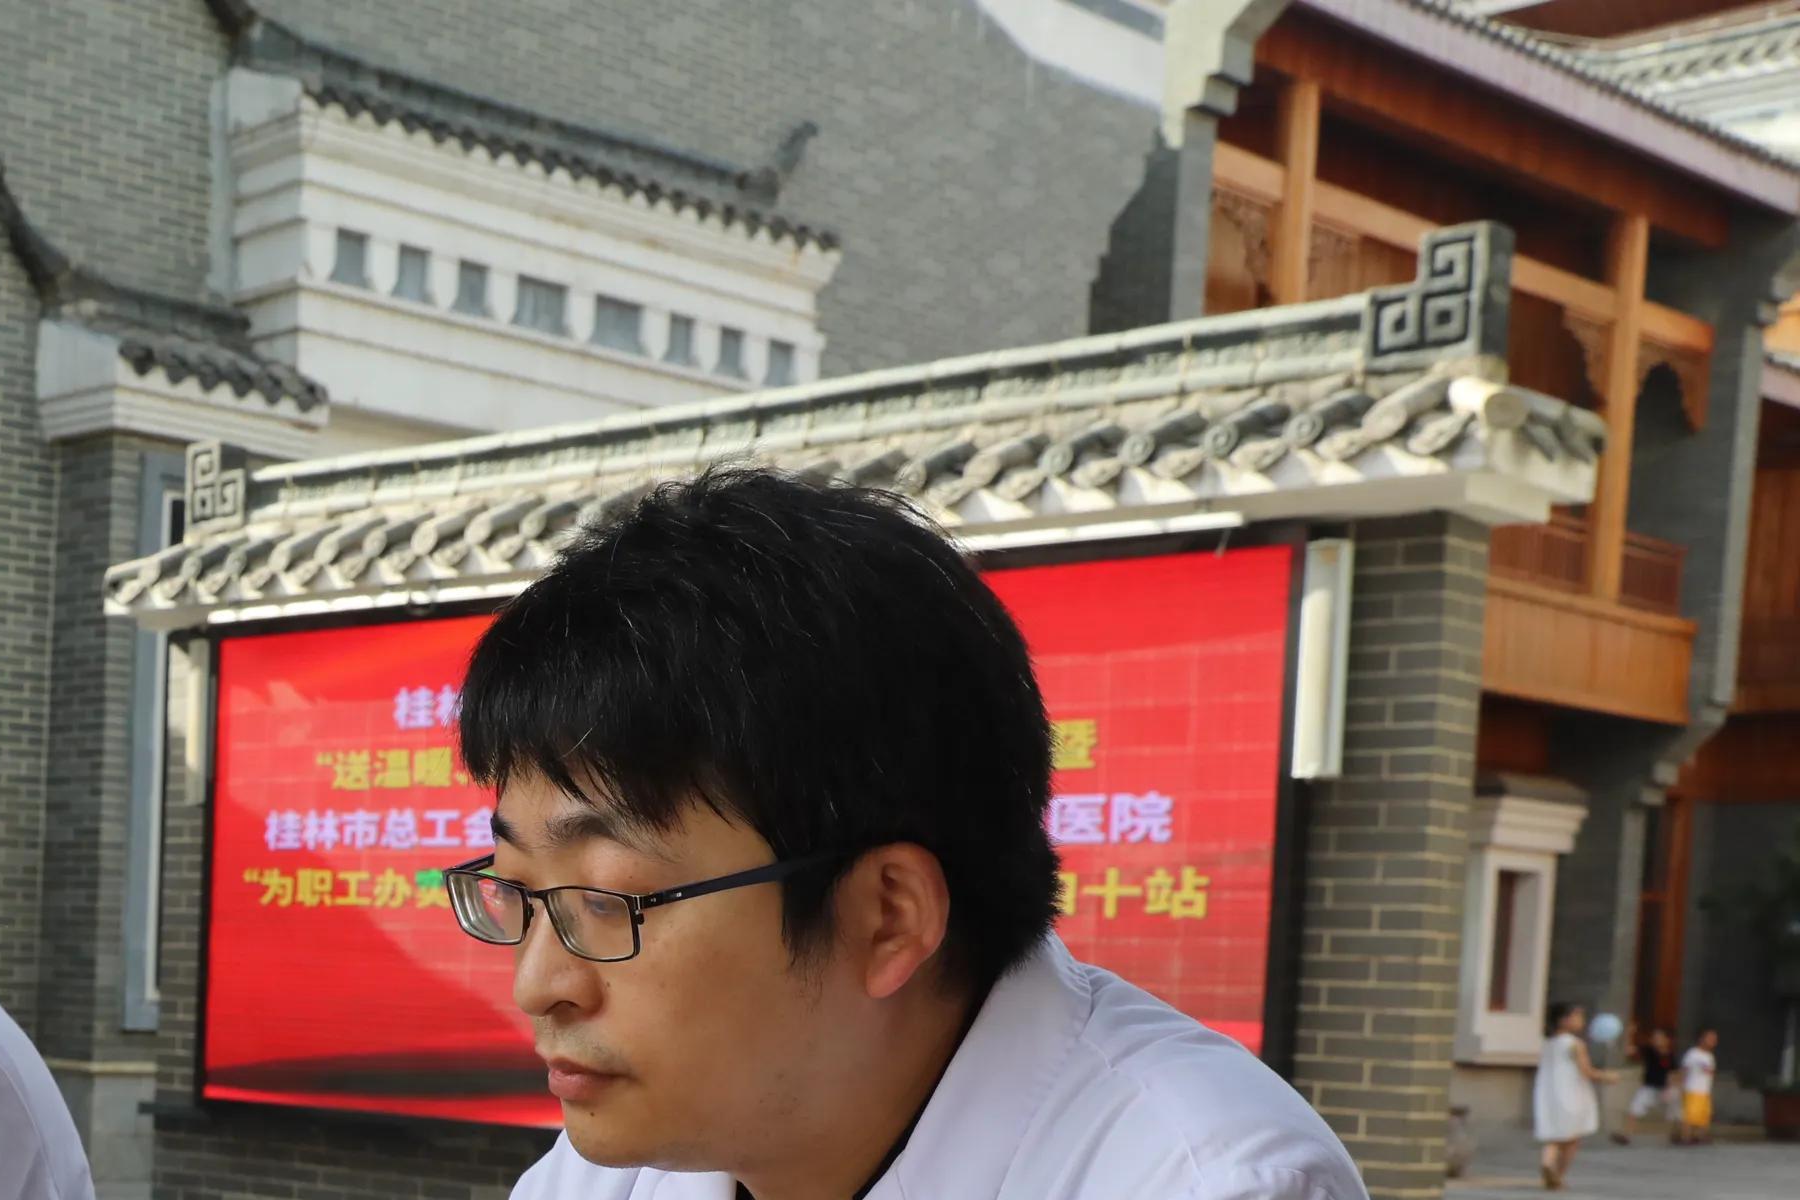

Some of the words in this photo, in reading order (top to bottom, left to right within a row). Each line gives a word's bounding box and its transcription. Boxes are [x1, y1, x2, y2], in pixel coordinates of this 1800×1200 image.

[265, 807, 496, 850] 桂林市总工会
[1046, 791, 1174, 844] 医院
